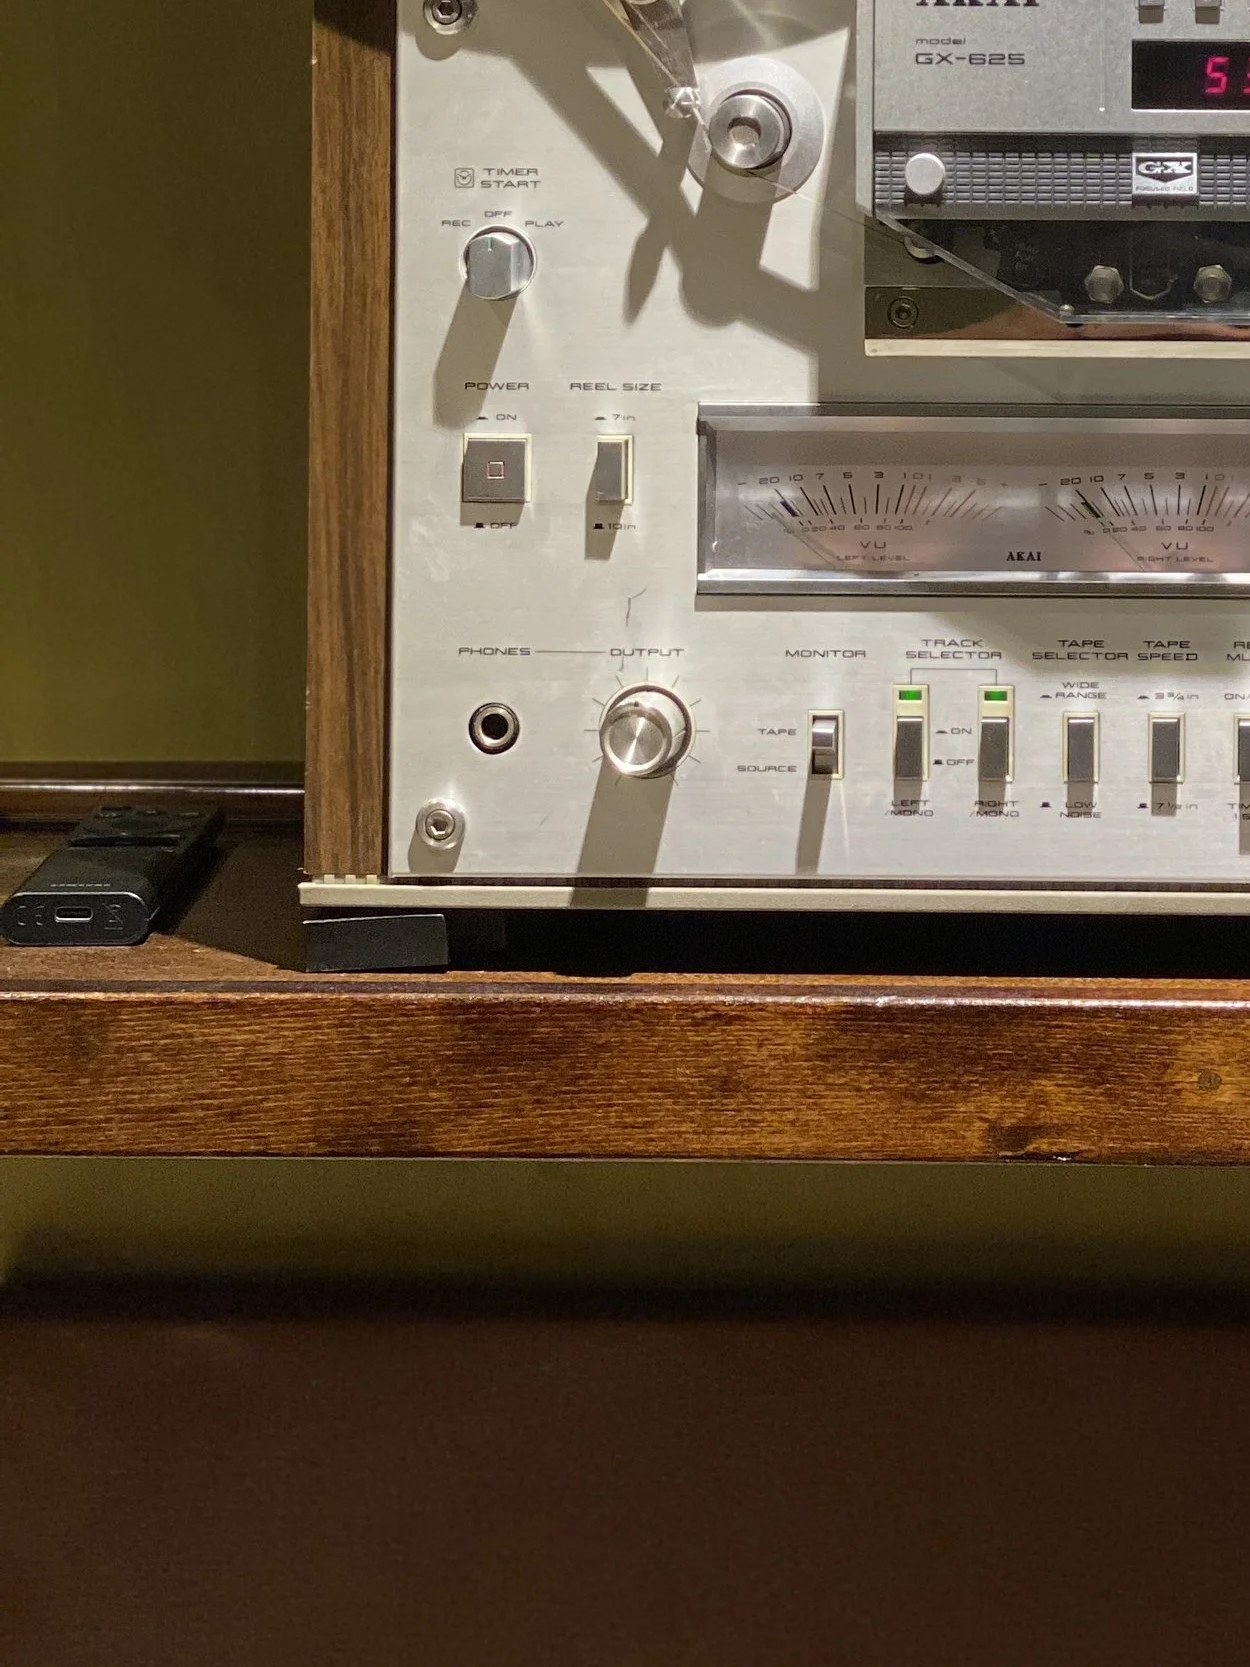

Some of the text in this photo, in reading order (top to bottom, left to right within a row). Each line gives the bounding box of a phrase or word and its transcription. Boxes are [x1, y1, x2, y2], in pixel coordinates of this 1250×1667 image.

[915, 37, 966, 46] model
[915, 52, 1026, 65] GX-625
[483, 167, 539, 177] TIMER
[1138, 161, 1192, 174] GX
[480, 180, 541, 189] START
[484, 210, 512, 218] OFF
[441, 219, 472, 227] REC
[464, 381, 530, 391] POWER
[569, 382, 662, 391] REEL SIZE
[758, 476, 780, 484] 20
[789, 474, 804, 482] 10
[874, 471, 884, 479] 3
[1060, 477, 1082, 485] 20
[1089, 475, 1104, 483] 10
[1144, 472, 1155, 480] 5
[1175, 472, 1185, 480] 3
[490, 522, 518, 530] OFF
[860, 541, 887, 549] VU
[1161, 542, 1189, 550] VU
[1006, 551, 1042, 562] AKAI
[921, 638, 983, 648] TRACK
[1057, 639, 1105, 648] TAPE
[1143, 640, 1191, 649] TAPE
[458, 646, 685, 657] PHONES OUTPUT
[785, 648, 867, 659] MONITOR
[905, 651, 1002, 660] SELECTOR
[1032, 651, 1129, 661] SELECTOR
[1137, 652, 1198, 661] SPEED
[1062, 681, 1100, 689] WIDE
[1055, 692, 1108, 700] RANGE
[758, 728, 797, 736] TAPE
[950, 727, 973, 735] ON
[946, 758, 975, 766] OFF
[737, 764, 797, 773] SOURCE
[891, 799, 930, 808] LEFT
[974, 800, 1018, 809] RIGHT
[1065, 800, 1098, 810] LOW
[883, 809, 934, 818] /MONO
[969, 809, 1020, 819] /MONO
[1059, 810, 1102, 819] NOISE
